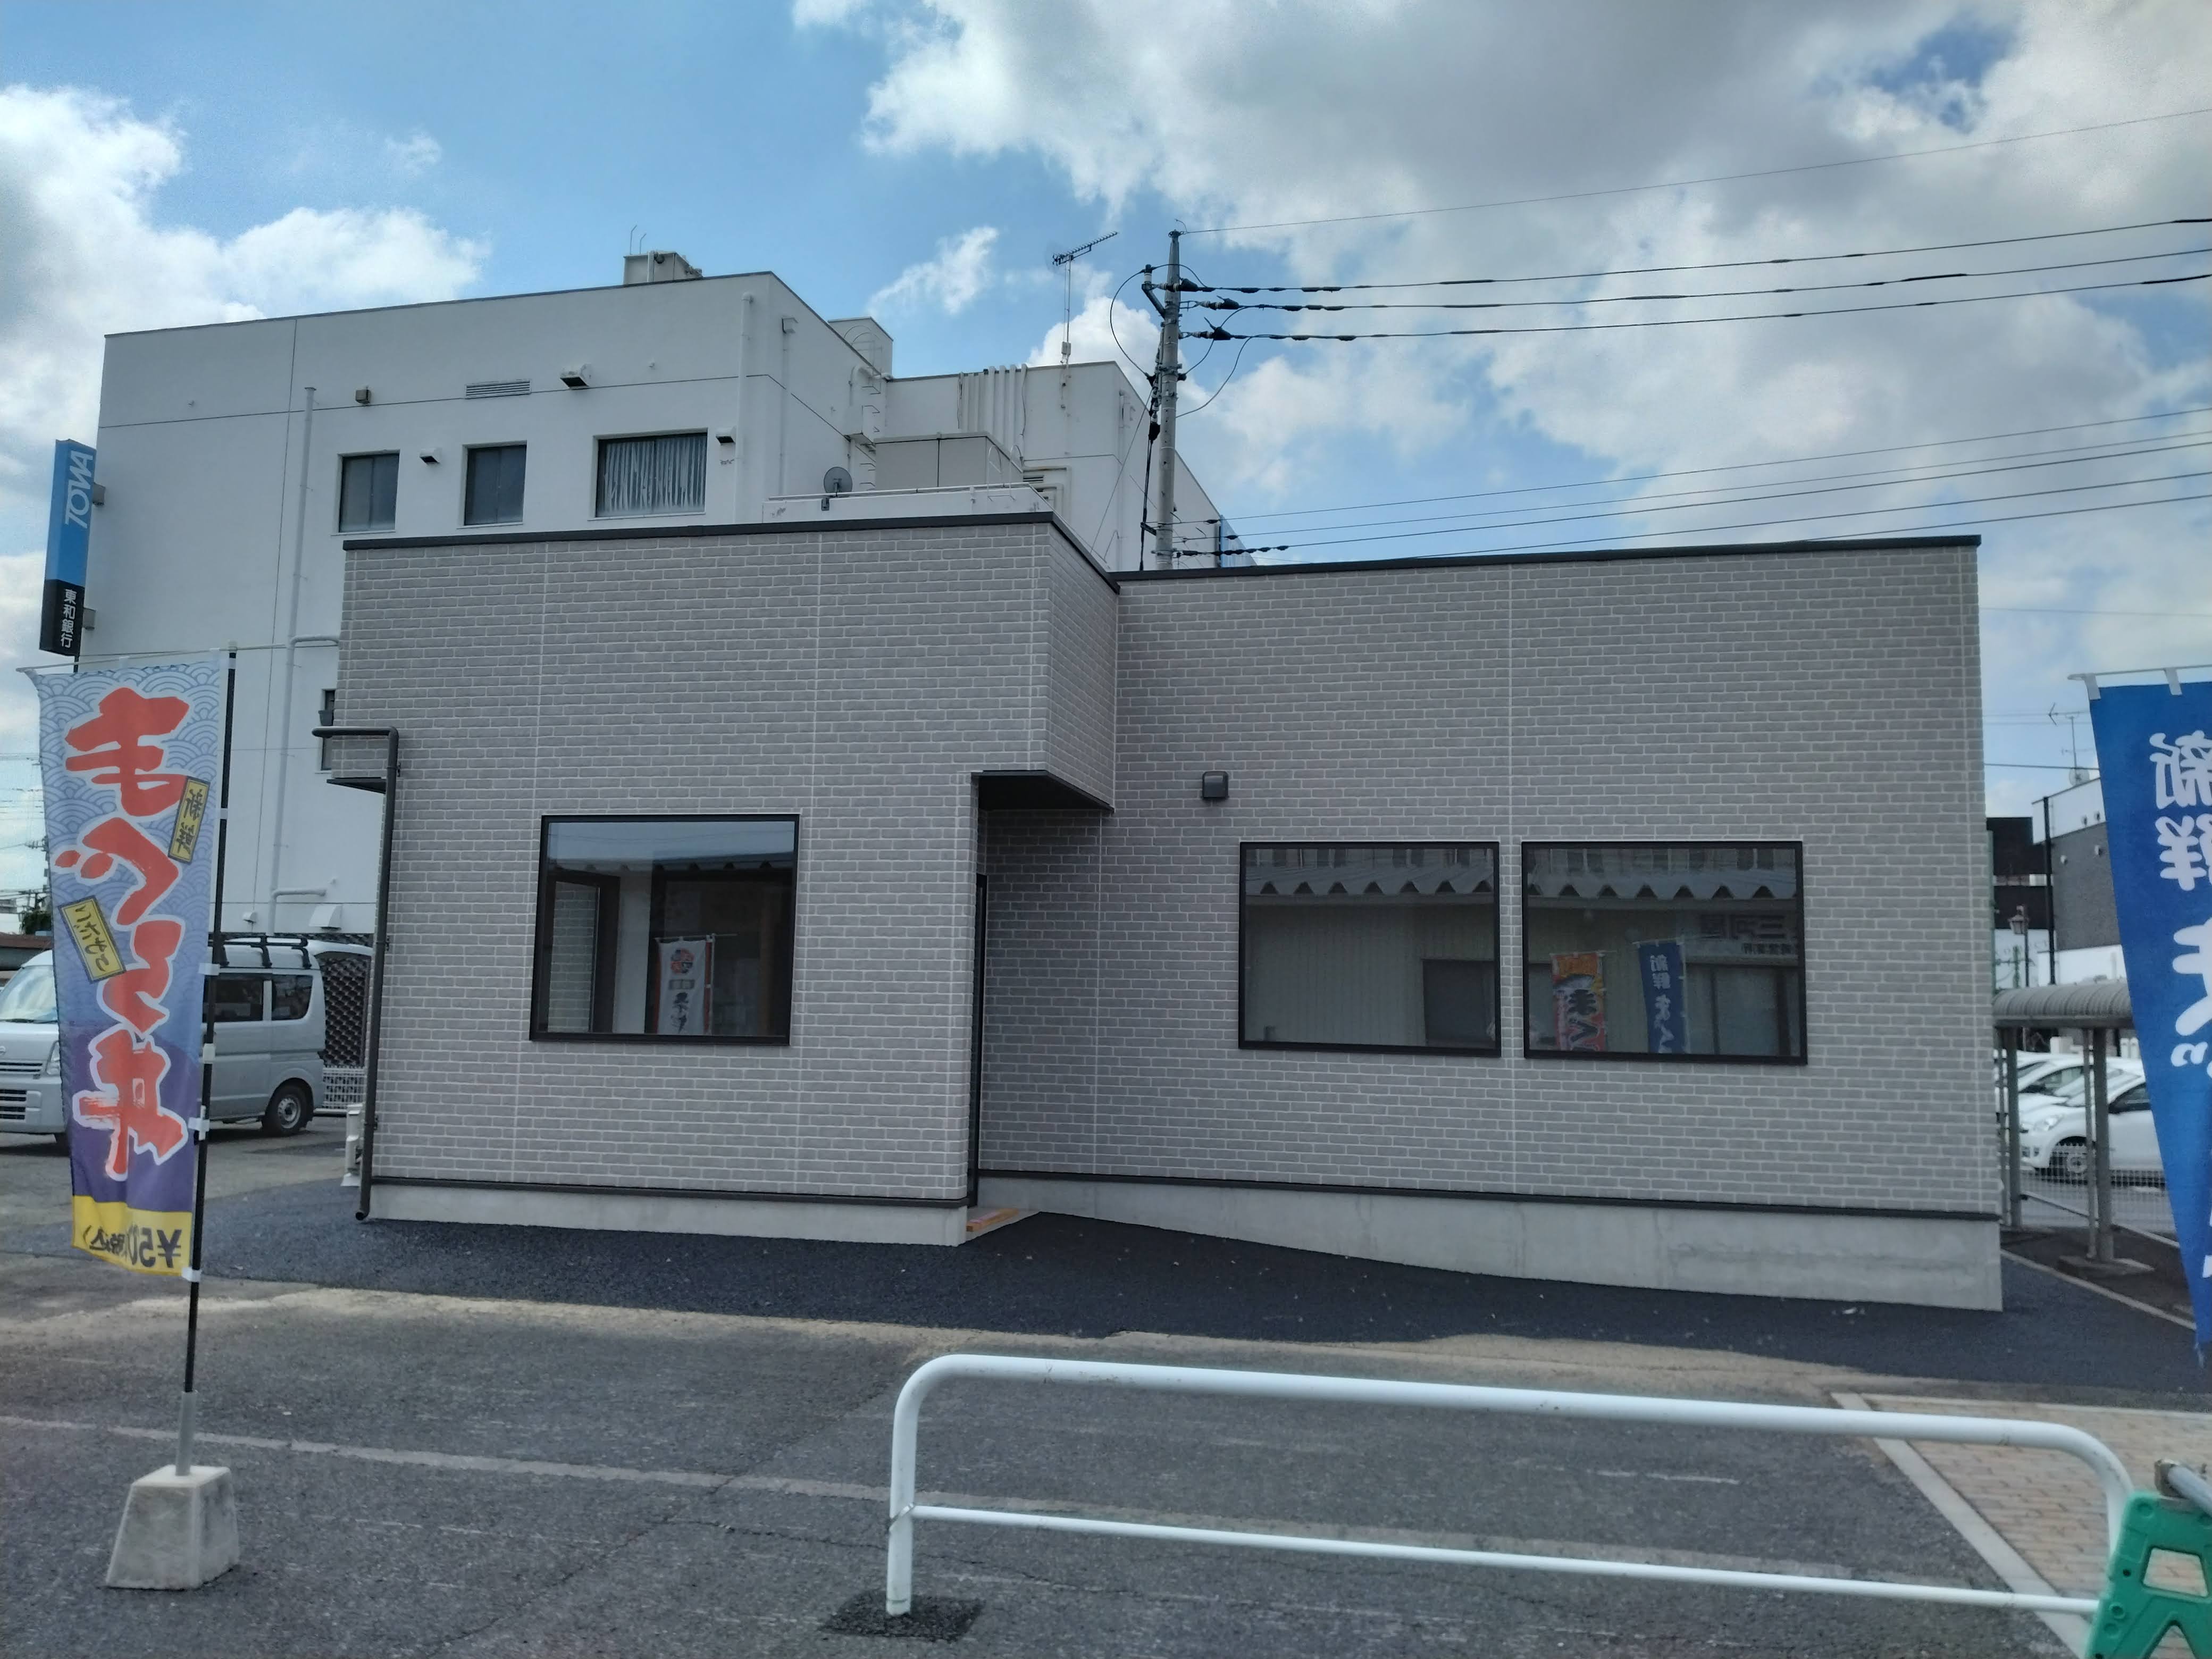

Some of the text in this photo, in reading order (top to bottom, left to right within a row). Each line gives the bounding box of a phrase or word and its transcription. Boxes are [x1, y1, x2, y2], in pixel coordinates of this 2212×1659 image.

[65, 450, 94, 529] TOWA
[60, 589, 77, 649] 東和銀行
